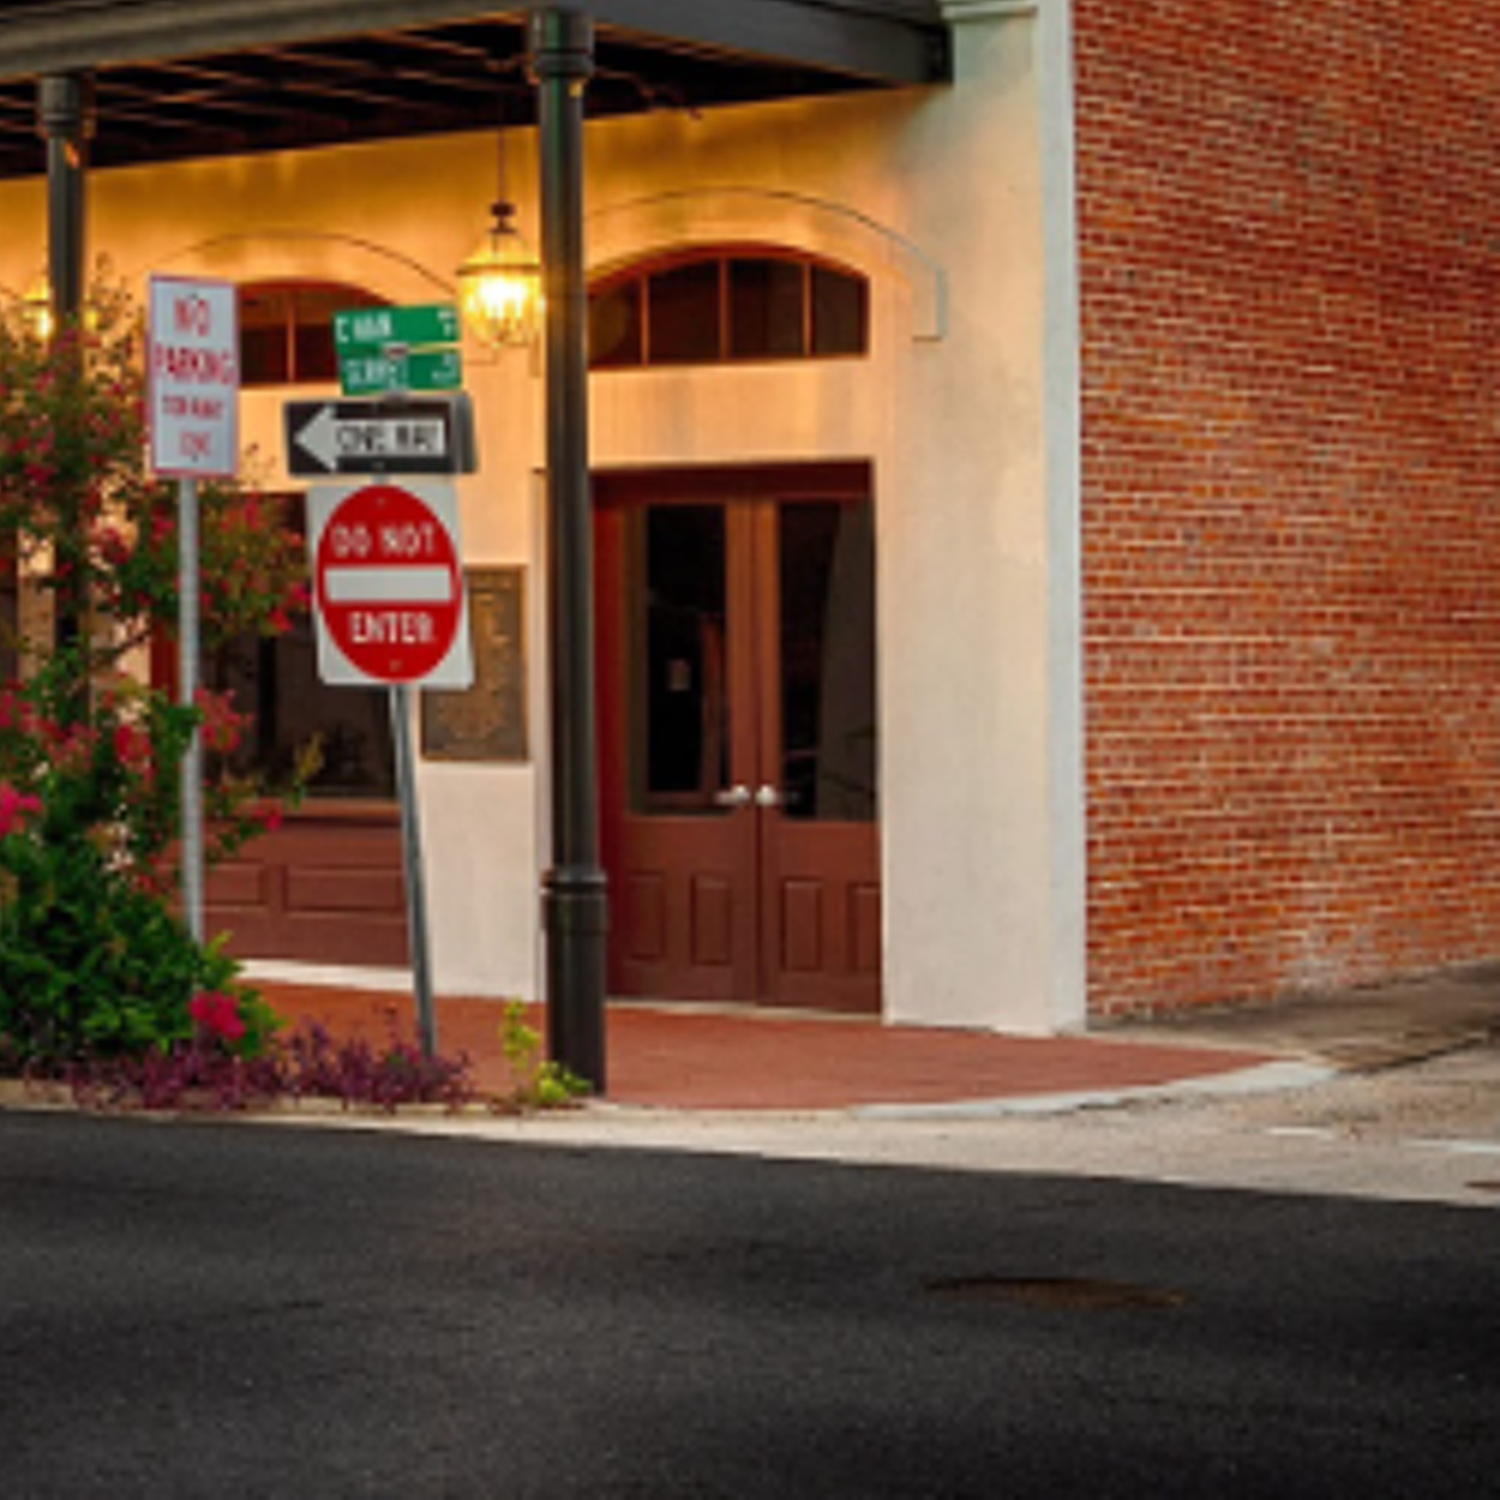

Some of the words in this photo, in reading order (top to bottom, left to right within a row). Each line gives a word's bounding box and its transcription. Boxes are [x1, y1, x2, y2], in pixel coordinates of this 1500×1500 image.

[174, 297, 210, 337] NO
[155, 342, 235, 385] PARKING
[396, 422, 439, 450] WAY
[330, 523, 373, 559] DO
[378, 521, 435, 558] NOT
[348, 610, 437, 645] ENTER
